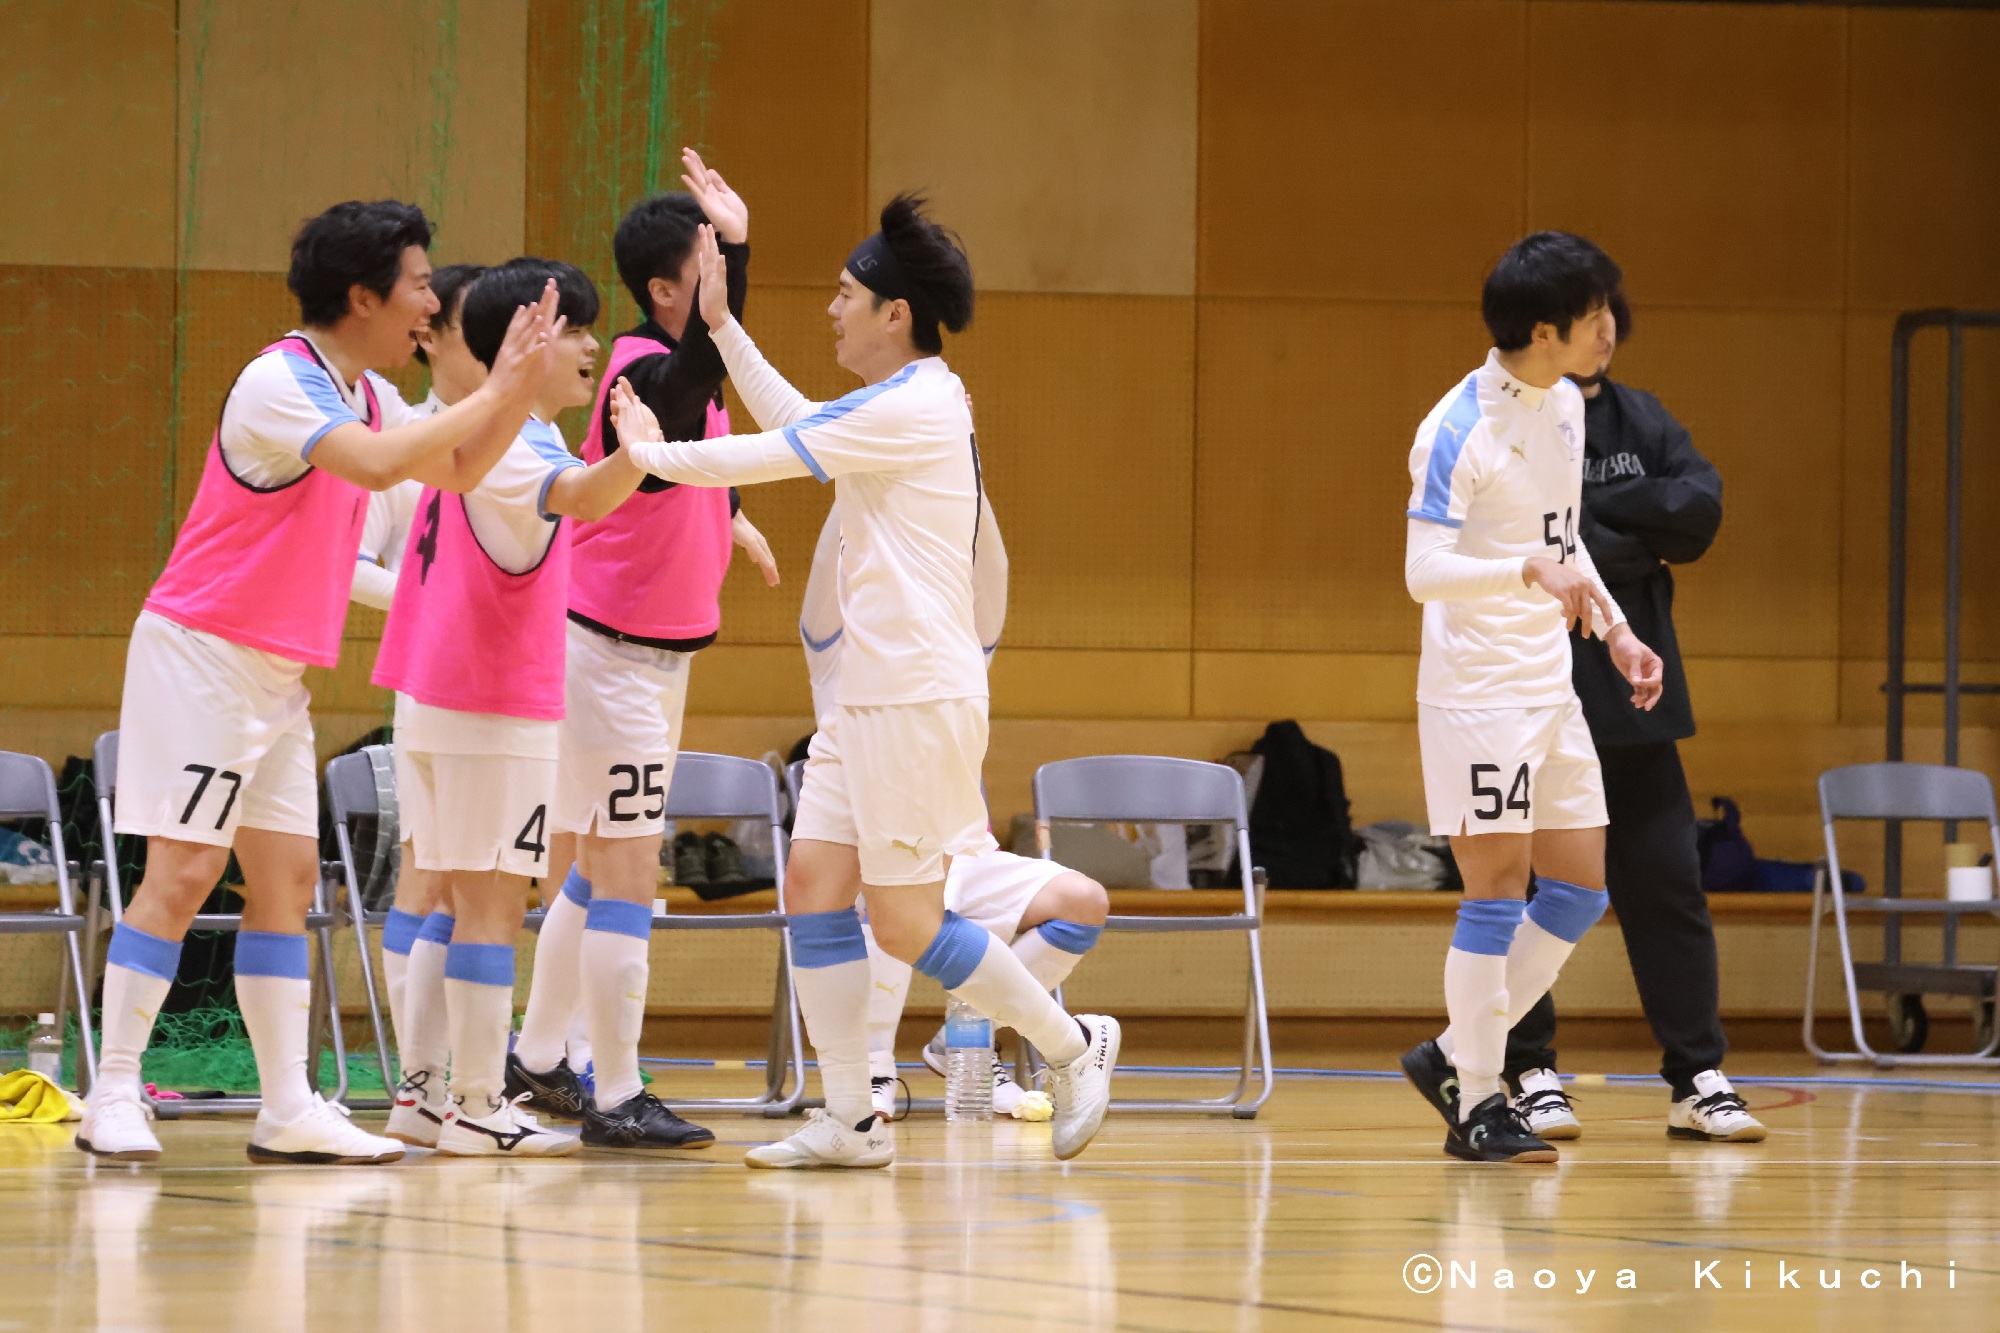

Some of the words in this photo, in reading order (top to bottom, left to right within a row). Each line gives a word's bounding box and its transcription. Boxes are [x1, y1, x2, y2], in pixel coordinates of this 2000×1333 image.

[1543, 506, 1576, 565] 54
[179, 764, 242, 831] 77
[608, 763, 665, 822] 25
[1471, 762, 1530, 820] 54
[514, 803, 546, 863] 4
[1095, 1024, 1108, 1071] ATHLETA
